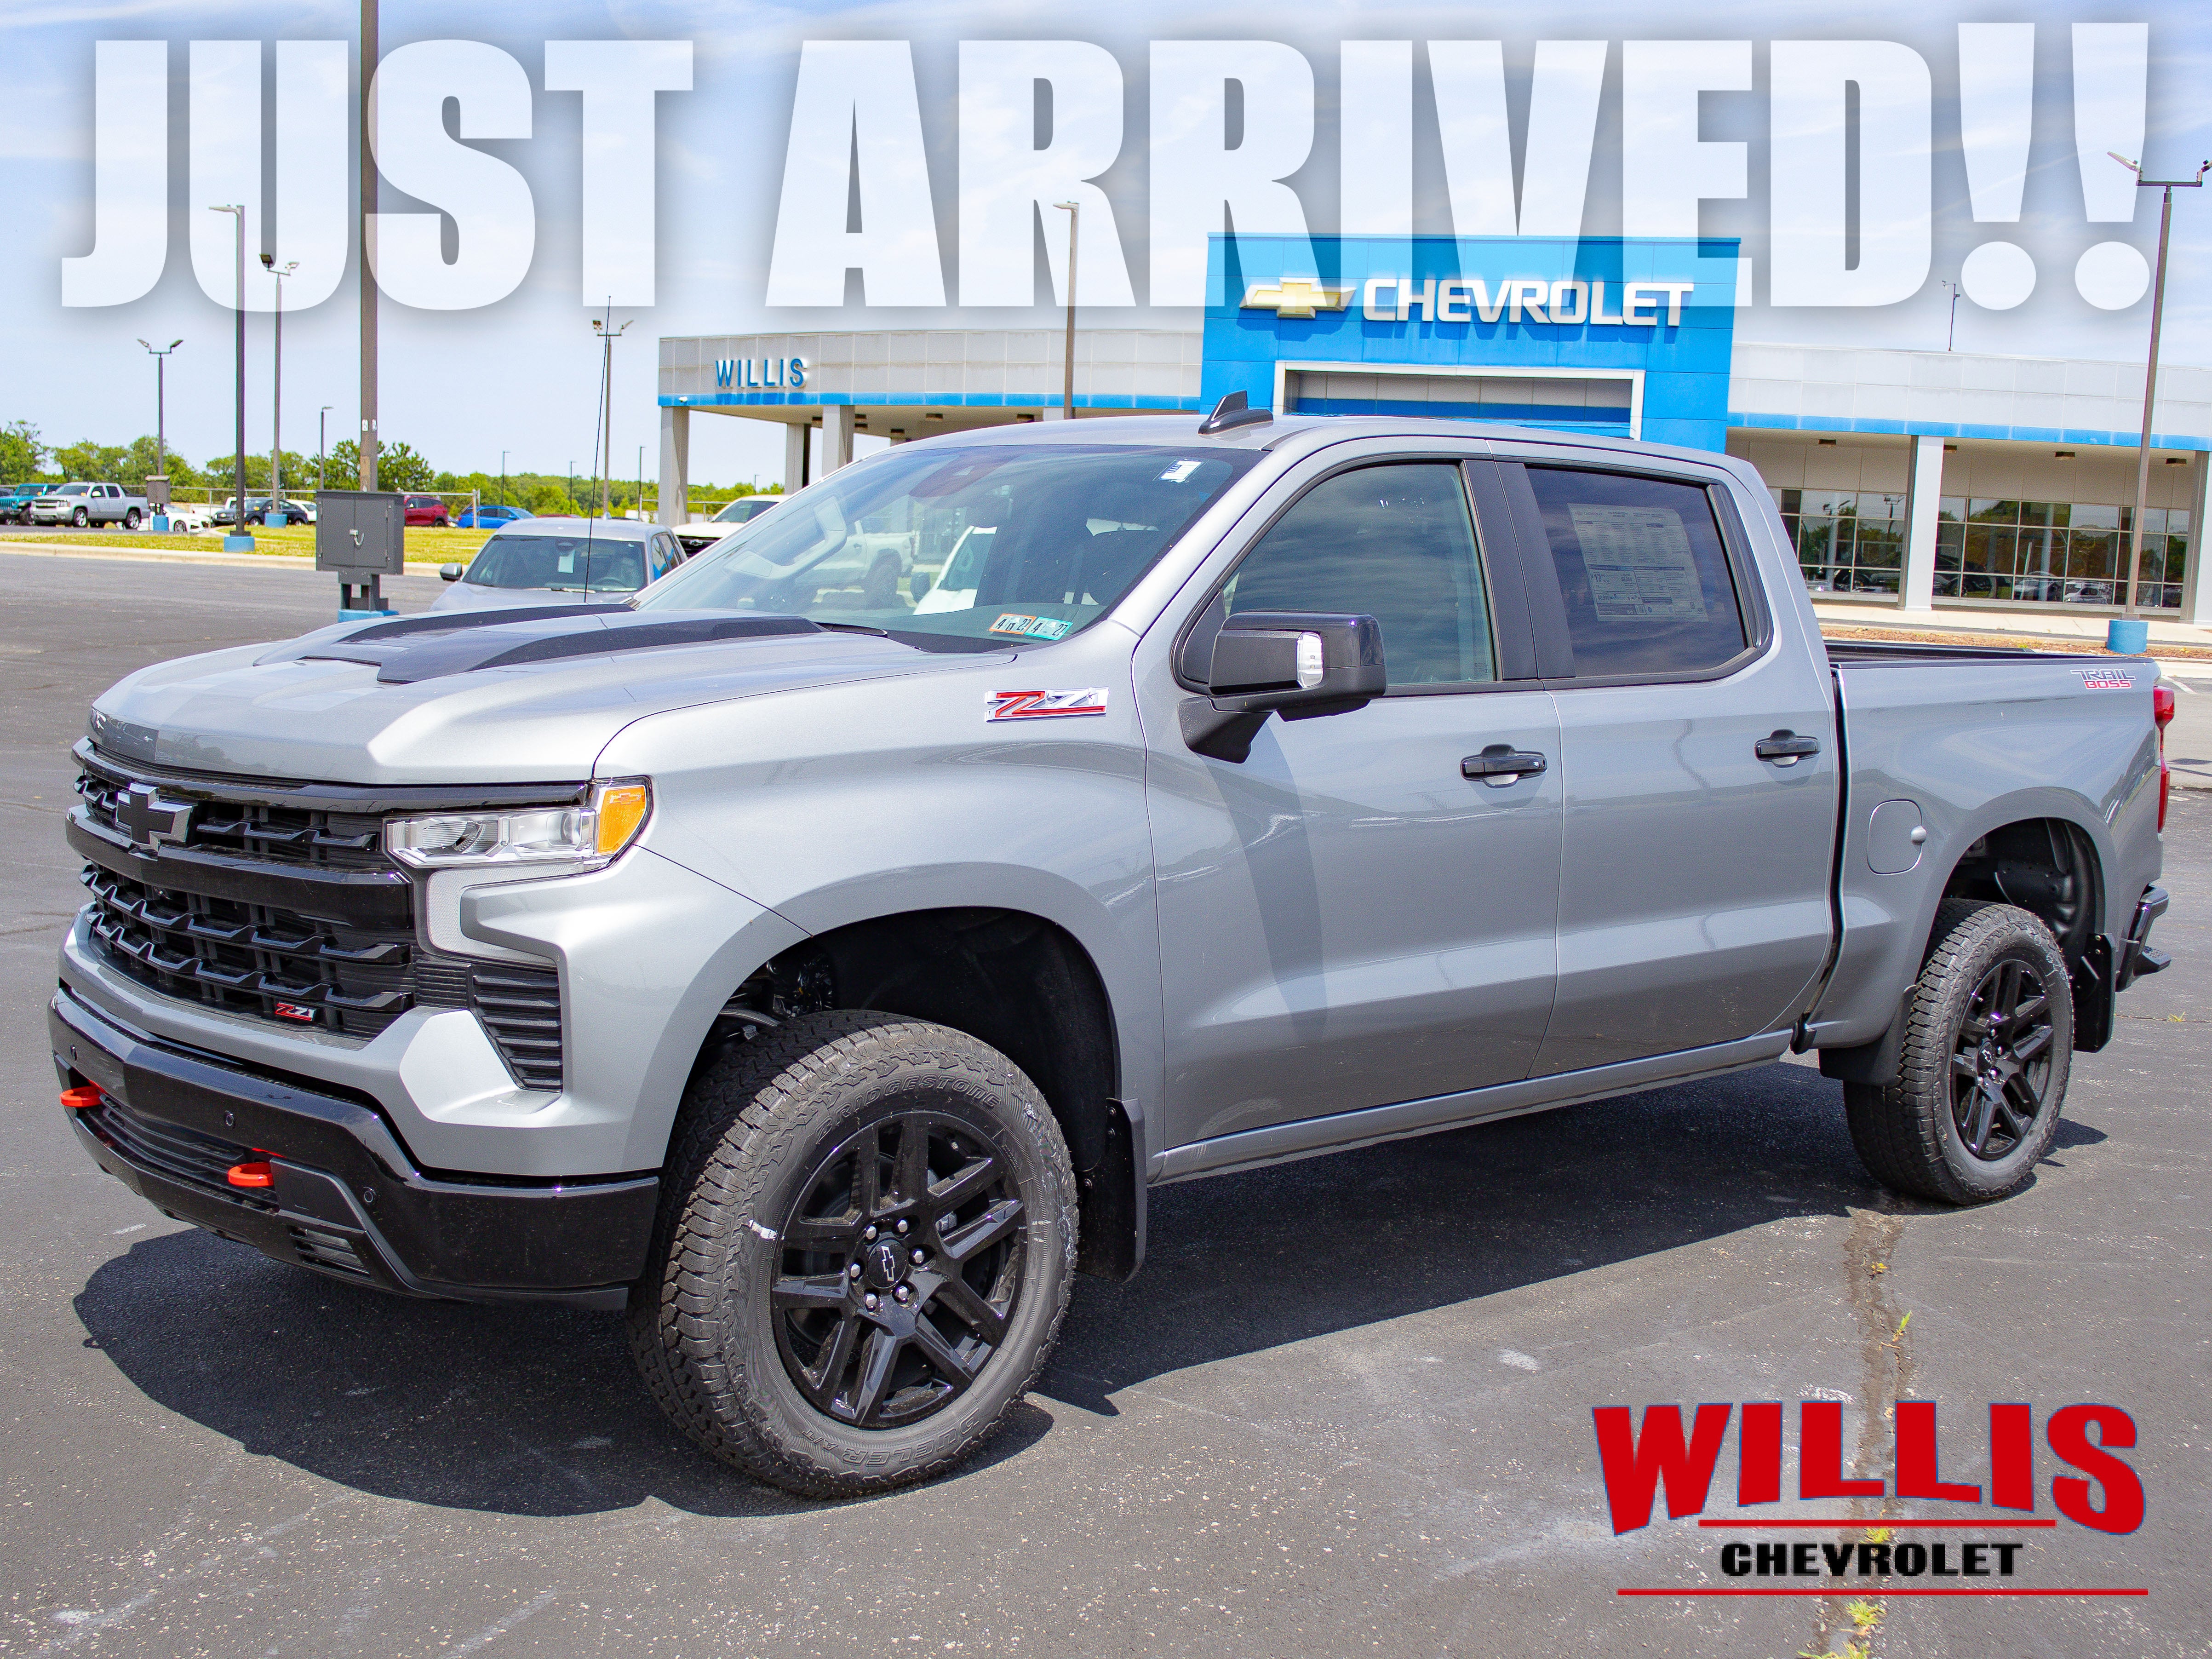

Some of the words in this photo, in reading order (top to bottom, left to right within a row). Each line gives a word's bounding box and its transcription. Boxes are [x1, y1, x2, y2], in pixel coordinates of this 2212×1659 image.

[1363, 278, 1694, 327] CHEVROLET
[716, 358, 808, 388] WILLIS
[997, 619, 1007, 629] 4
[1032, 623, 1043, 633] 4
[2070, 669, 2136, 681] TRAIL
[2084, 680, 2132, 689] BOSS
[985, 687, 1109, 723] Z71
[275, 1002, 316, 1021] Z71
[815, 1074, 1002, 1145] BRIDGESTONE
[802, 1429, 839, 1451] A/T
[842, 1407, 980, 1467] DUELER
